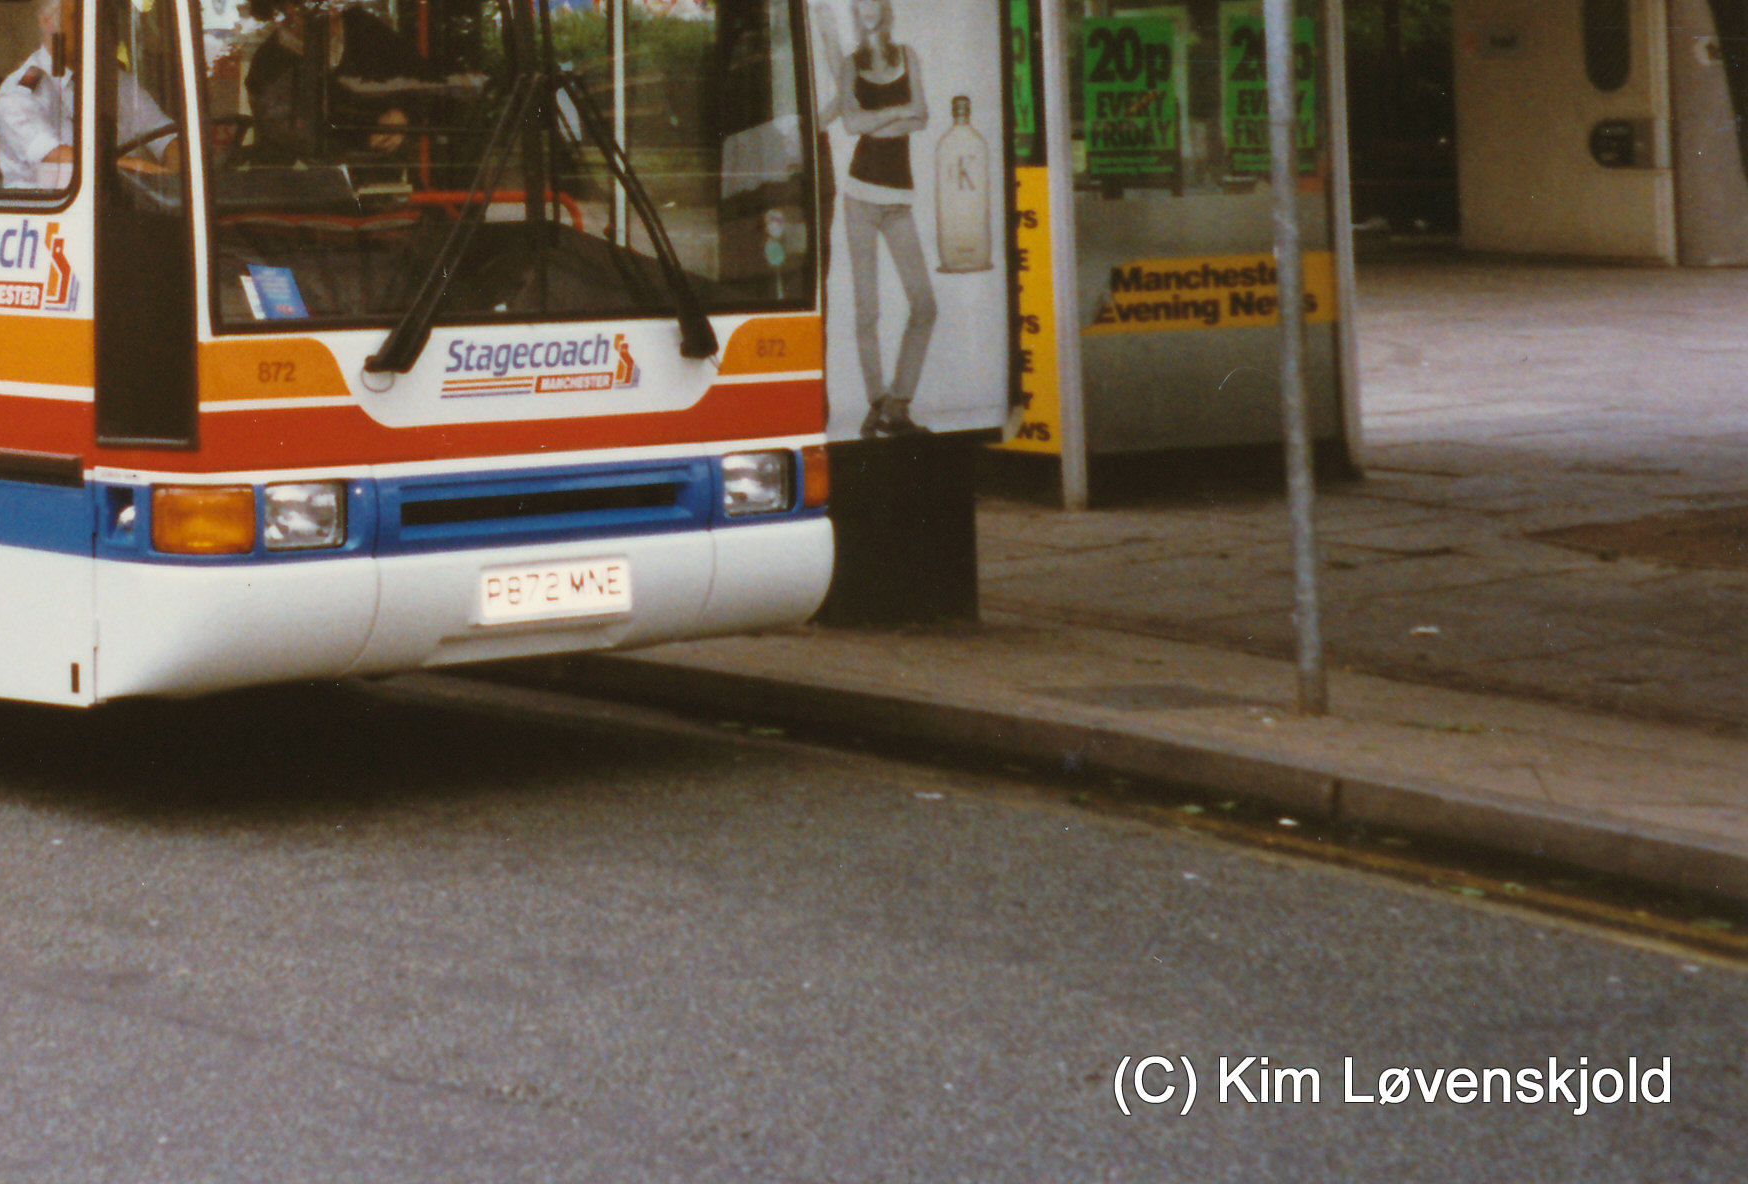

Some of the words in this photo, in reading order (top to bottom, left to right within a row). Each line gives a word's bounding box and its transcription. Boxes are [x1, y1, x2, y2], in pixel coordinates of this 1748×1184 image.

[1087, 26, 1173, 90] 20p
[1230, 25, 1313, 82] 2p
[1097, 91, 1166, 118] EVERY
[1091, 119, 1173, 148] FRIDAY
[1110, 261, 1277, 292] Manchest
[1229, 291, 1318, 317] Nes
[445, 334, 610, 376] Stagecoach
[757, 339, 786, 358] 872
[258, 361, 297, 383] 872
[540, 373, 610, 390] MANCHESTER
[487, 572, 560, 605] P872
[570, 566, 622, 596] MNE
